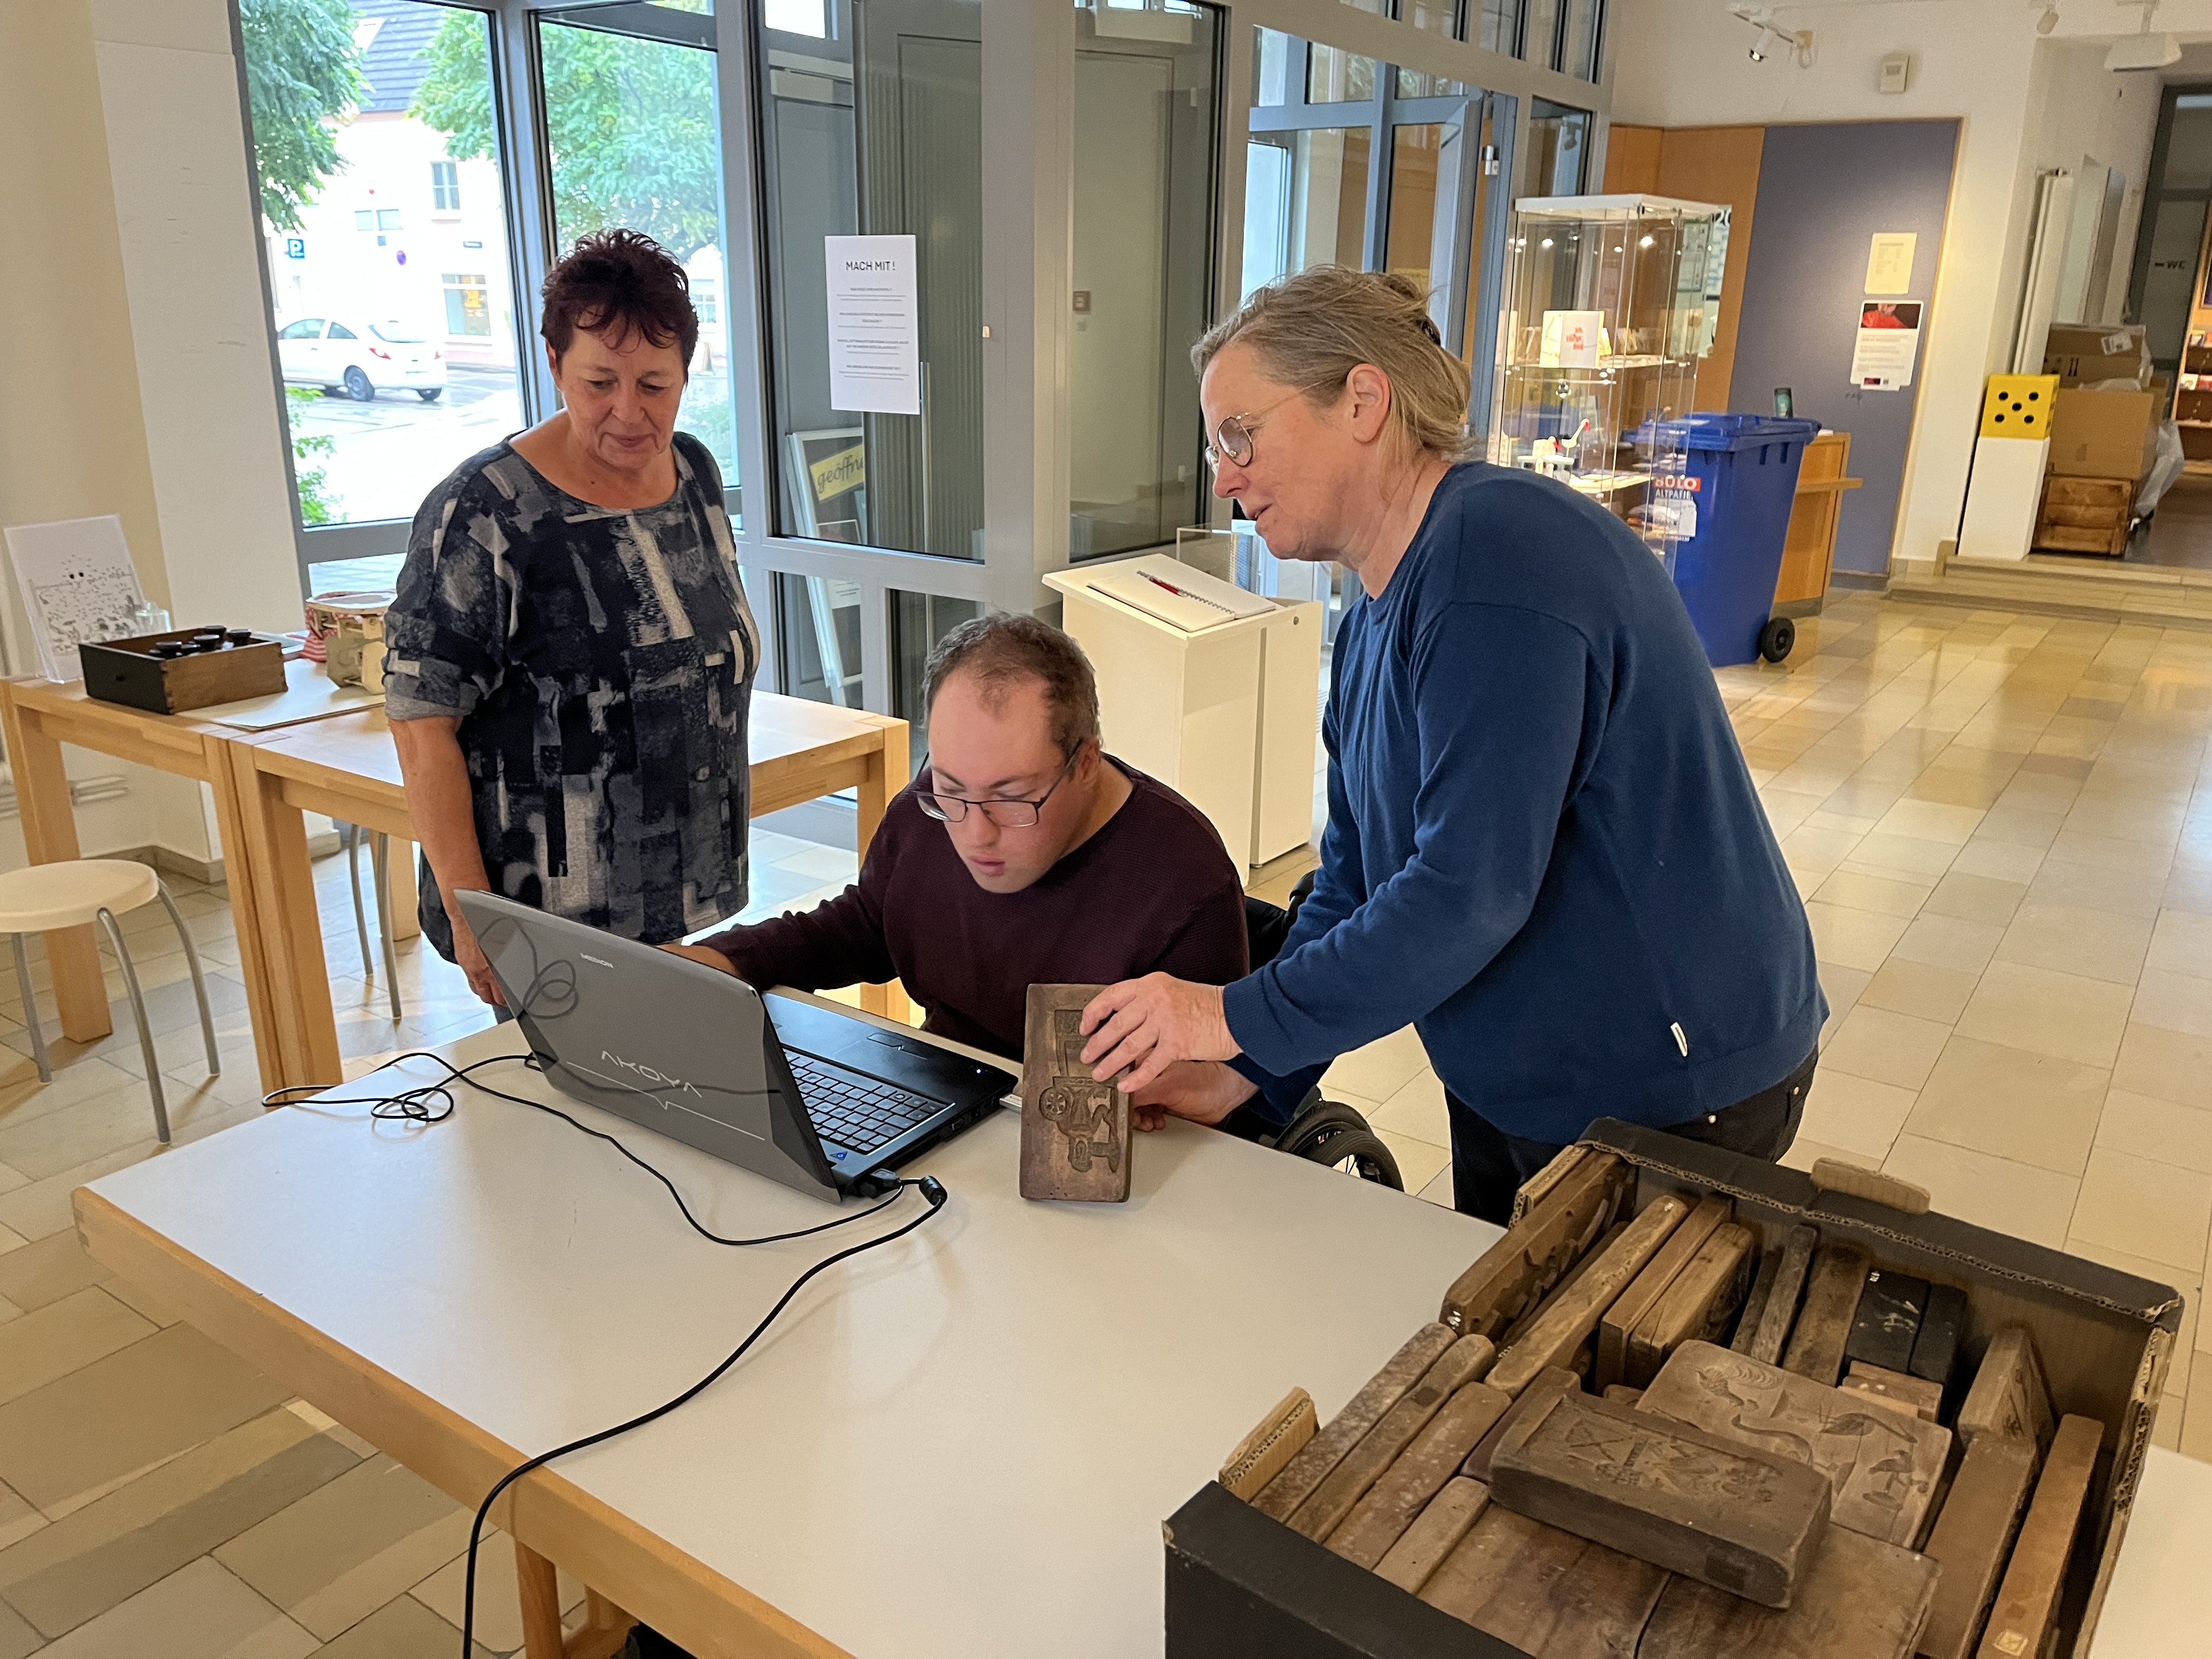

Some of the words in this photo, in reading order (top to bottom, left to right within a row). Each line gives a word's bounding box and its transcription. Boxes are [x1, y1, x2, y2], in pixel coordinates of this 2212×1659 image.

[289, 240, 302, 257] P
[845, 261, 872, 271] MACH
[2167, 259, 2186, 269] WC
[601, 1050, 702, 1098] AKOYA
